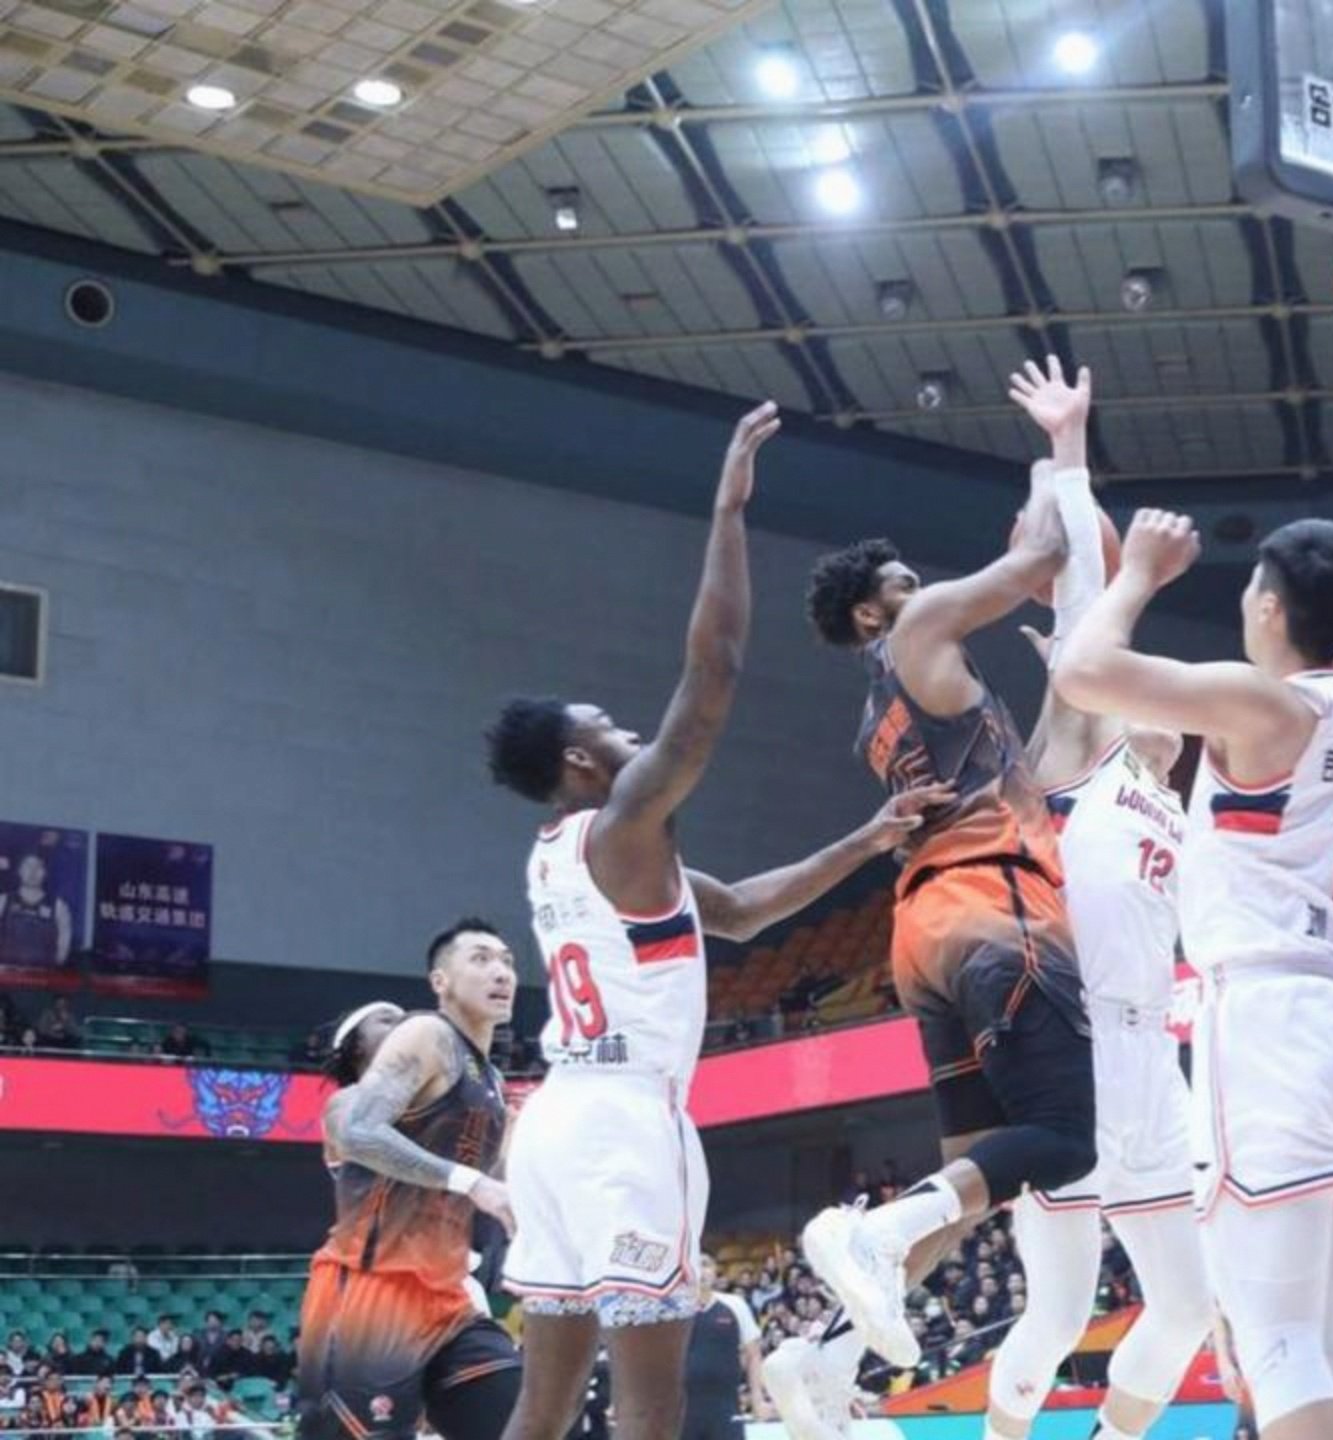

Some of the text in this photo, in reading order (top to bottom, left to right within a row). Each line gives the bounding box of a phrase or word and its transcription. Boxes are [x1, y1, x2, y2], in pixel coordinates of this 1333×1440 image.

[1137, 837, 1175, 895] 12
[118, 881, 190, 905] 山东高速
[100, 901, 206, 929] 轨道交通集团
[547, 942, 609, 1047] 19
